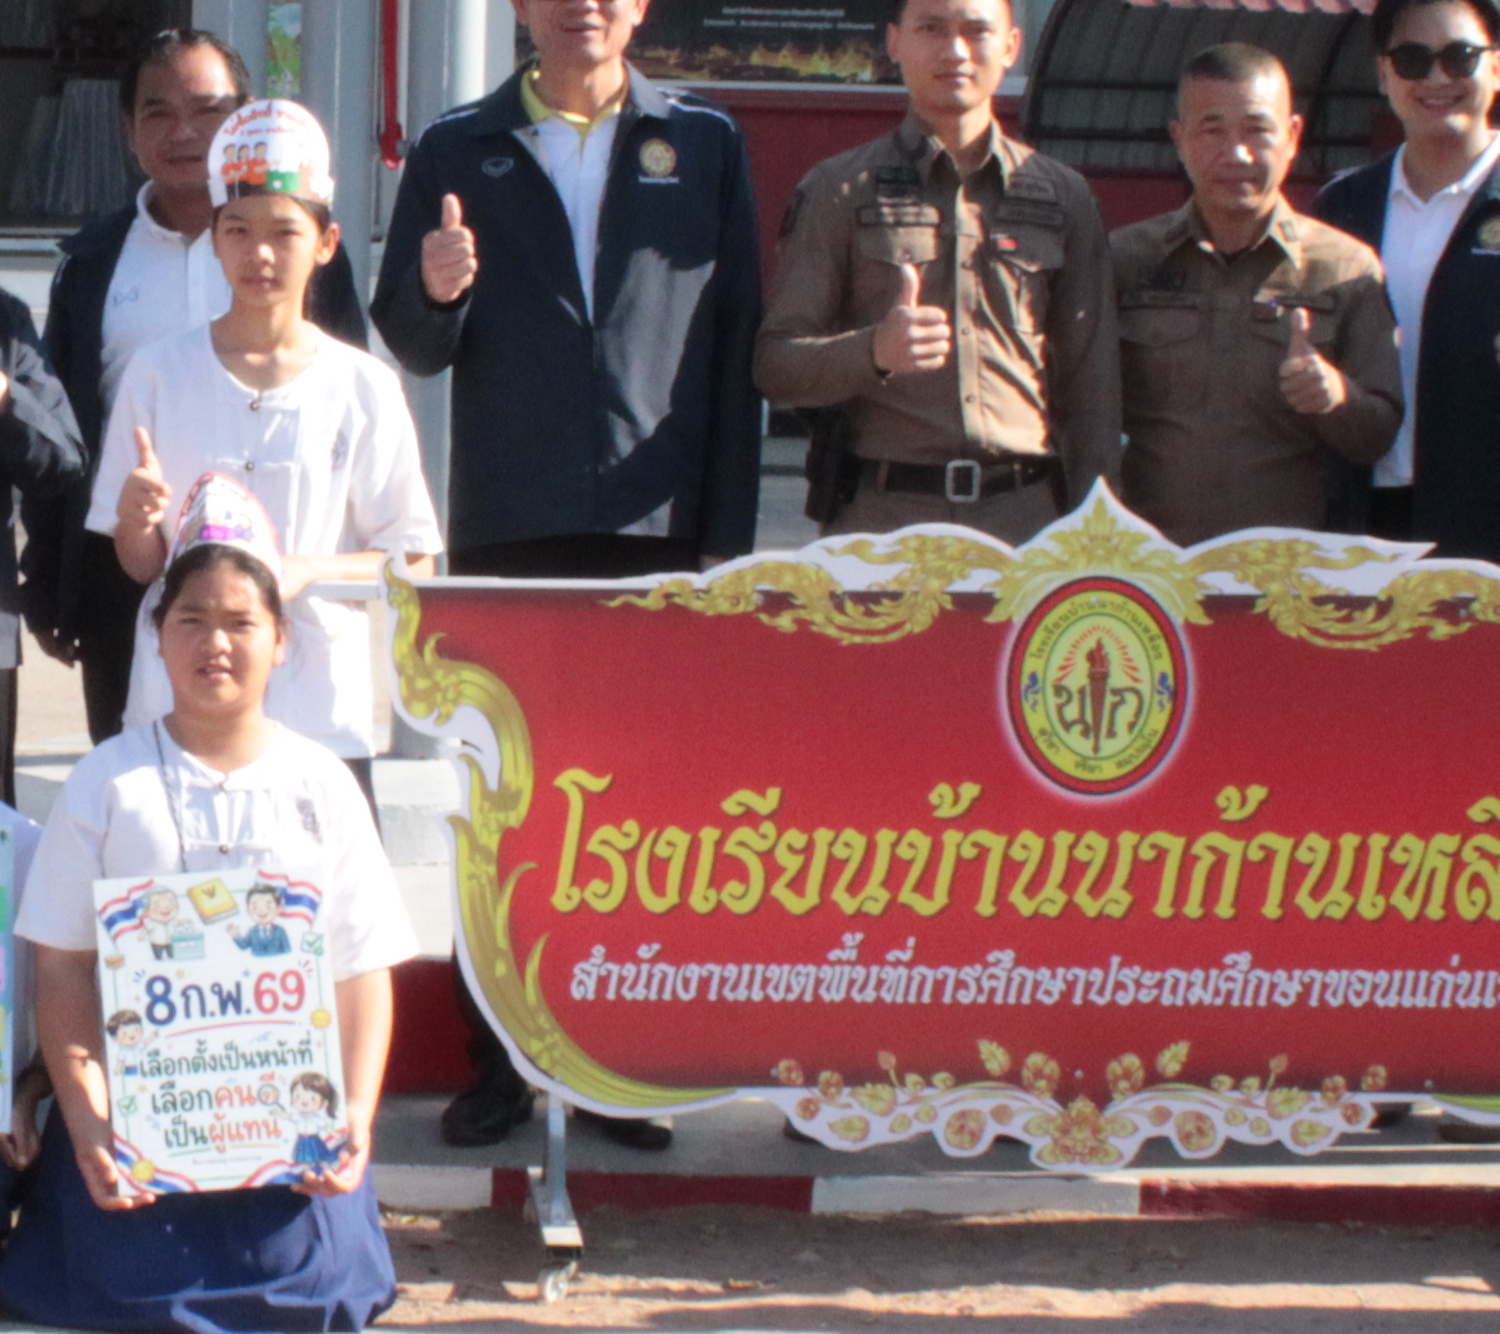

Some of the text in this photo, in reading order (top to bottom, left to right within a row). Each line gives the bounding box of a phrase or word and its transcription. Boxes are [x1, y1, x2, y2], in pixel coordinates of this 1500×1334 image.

[139, 1030, 314, 1079] เลือกตั้งเป็นหน้าที่
[150, 1073, 280, 1115] เลือกคนดี
[163, 1111, 283, 1154] เป็นผู้แทน
